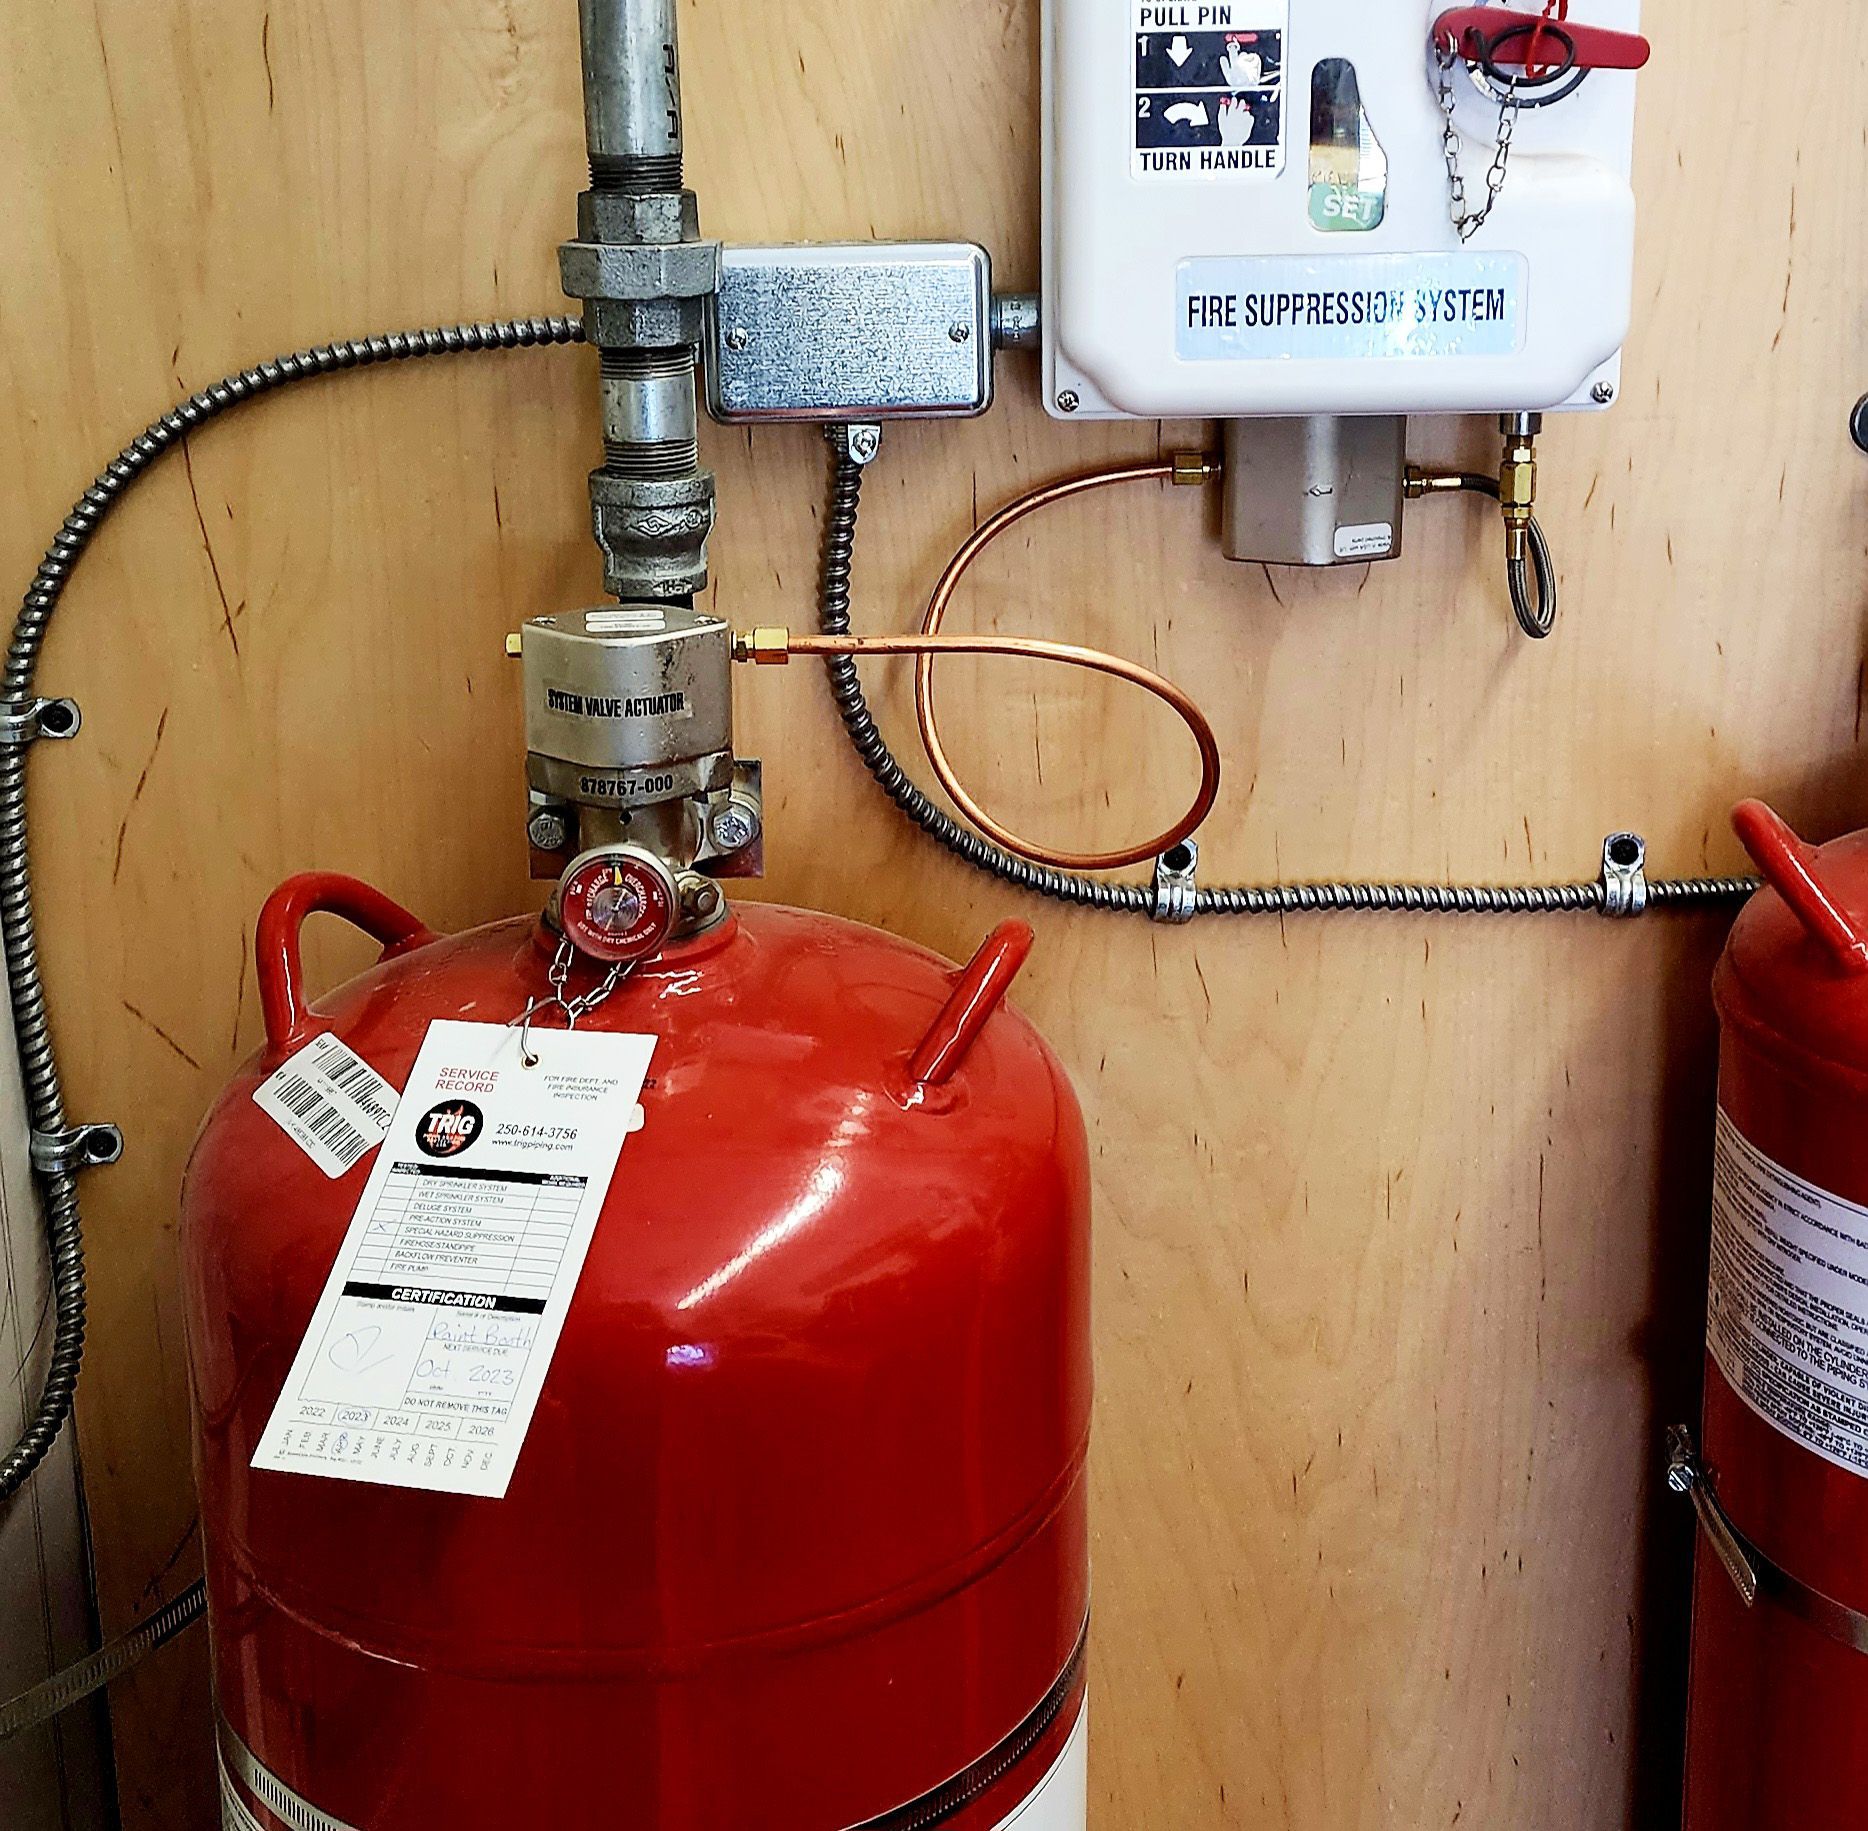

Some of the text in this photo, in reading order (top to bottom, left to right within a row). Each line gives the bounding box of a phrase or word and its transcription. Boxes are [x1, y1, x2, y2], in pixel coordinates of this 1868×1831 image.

[1140, 6, 1231, 26] PULL PIN
[1138, 35, 1150, 56] 1
[1138, 97, 1150, 118] 2
[1140, 150, 1276, 171] TURN HANDLE
[1323, 193, 1375, 221] SET
[1188, 288, 1505, 328] FIRE SUPPRESSION SYSTEM
[548, 688, 684, 718] SYSTEM VALVE ACTUATOR
[439, 1067, 500, 1080] SERVICE
[435, 1079, 494, 1092] RECORD
[552, 1091, 598, 1101] INSPECTION
[427, 1113, 475, 1135] TRIG
[496, 1123, 578, 1140] 250-614-3756
[492, 1139, 573, 1152] www.trigpiping.com
[479, 1183, 508, 1192] SYSTEM
[414, 1202, 472, 1213] DELUGE SYSTEM
[475, 1194, 504, 1204] SYSTEM
[452, 1217, 482, 1227] SYSTEM
[404, 1225, 515, 1242] SPECIAL HAZARD SUPPRESSION
[395, 1250, 479, 1264] BACKFLOW PREVENTER
[389, 1262, 429, 1272] FIRE PUMP
[1827, 1263, 1847, 1277] UNDER
[391, 1288, 497, 1309] CERTIFICATION
[1820, 1299, 1844, 1316] PROPER
[1845, 1311, 1866, 1326] SEALS
[433, 1323, 477, 1342] Paint
[1806, 1341, 1822, 1358] THE
[1796, 1346, 1808, 1360] TO
[1808, 1354, 1826, 1371] THE
[1826, 1363, 1858, 1385] PIPING
[468, 1366, 514, 1385] 2023
[403, 1397, 508, 1415] DO NOT REMOVE THIS TAG
[1824, 1386, 1856, 1407] VIOLENT
[299, 1405, 326, 1417] 2022
[342, 1410, 369, 1422] 2023
[383, 1415, 409, 1427] 2024
[425, 1419, 452, 1431] 2025
[1822, 1410, 1861, 1433] STAMPED
[297, 1430, 312, 1448] FEB
[315, 1432, 329, 1451] MAR
[352, 1435, 365, 1454] MAY
[369, 1436, 385, 1458] JUNE
[388, 1439, 402, 1460] JULY
[405, 1442, 420, 1463] AUG
[423, 1443, 438, 1466] SEPT
[461, 1448, 475, 1468] NOV
[479, 1452, 492, 1470] DEC
